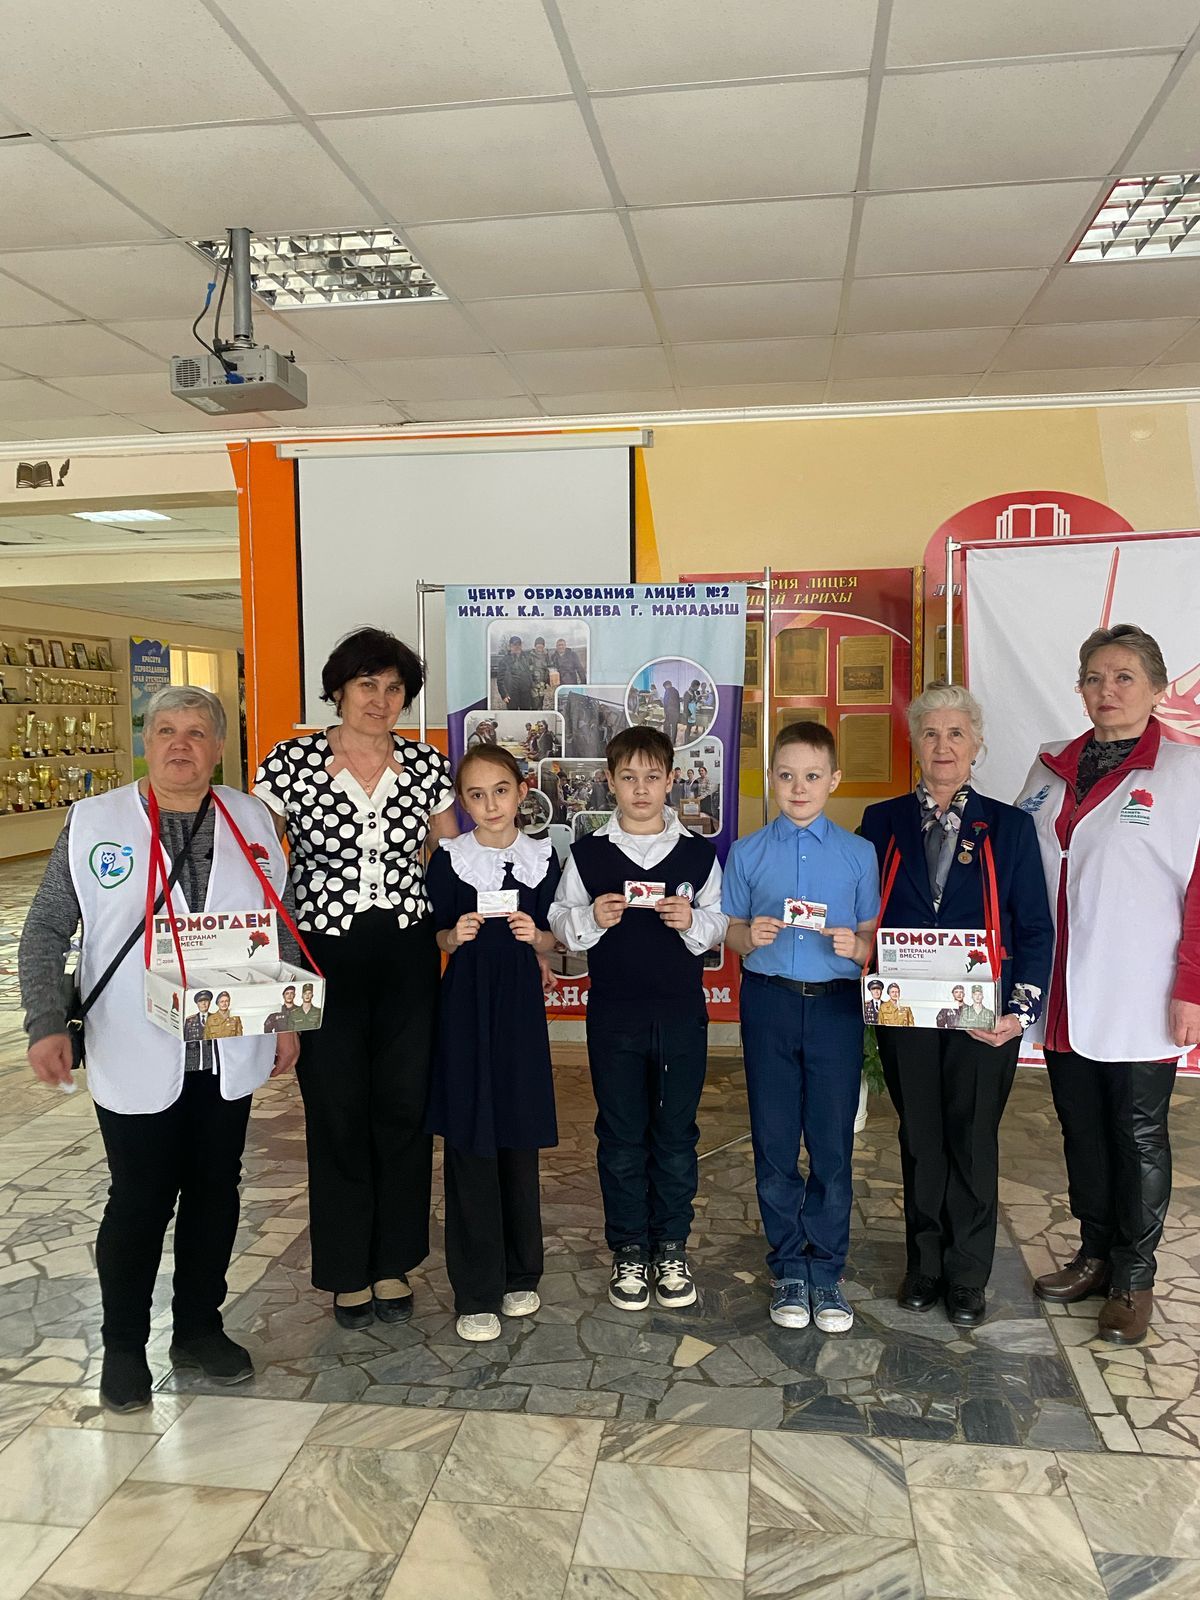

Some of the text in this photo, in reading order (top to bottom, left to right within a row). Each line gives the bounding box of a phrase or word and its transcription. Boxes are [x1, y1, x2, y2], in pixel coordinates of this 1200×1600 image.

[805, 576, 858, 590] ЛИЦЕЯ
[467, 584, 729, 602] ЦЕНТР ОБРАЗОВАНИЯ ЛИЦЕЙ №2
[793, 592, 853, 605] ТАРИХЫ
[458, 603, 739, 617] ИМ.АК. К.А. ВАЛИЕВА Г. МАМАДЫШ
[155, 913, 271, 933] ПОМОГАЕМ
[179, 934, 217, 942] ЕТЕРАНАМ
[180, 940, 204, 948] МЕСТЕ
[881, 932, 988, 947] ПОМОГАЕМ
